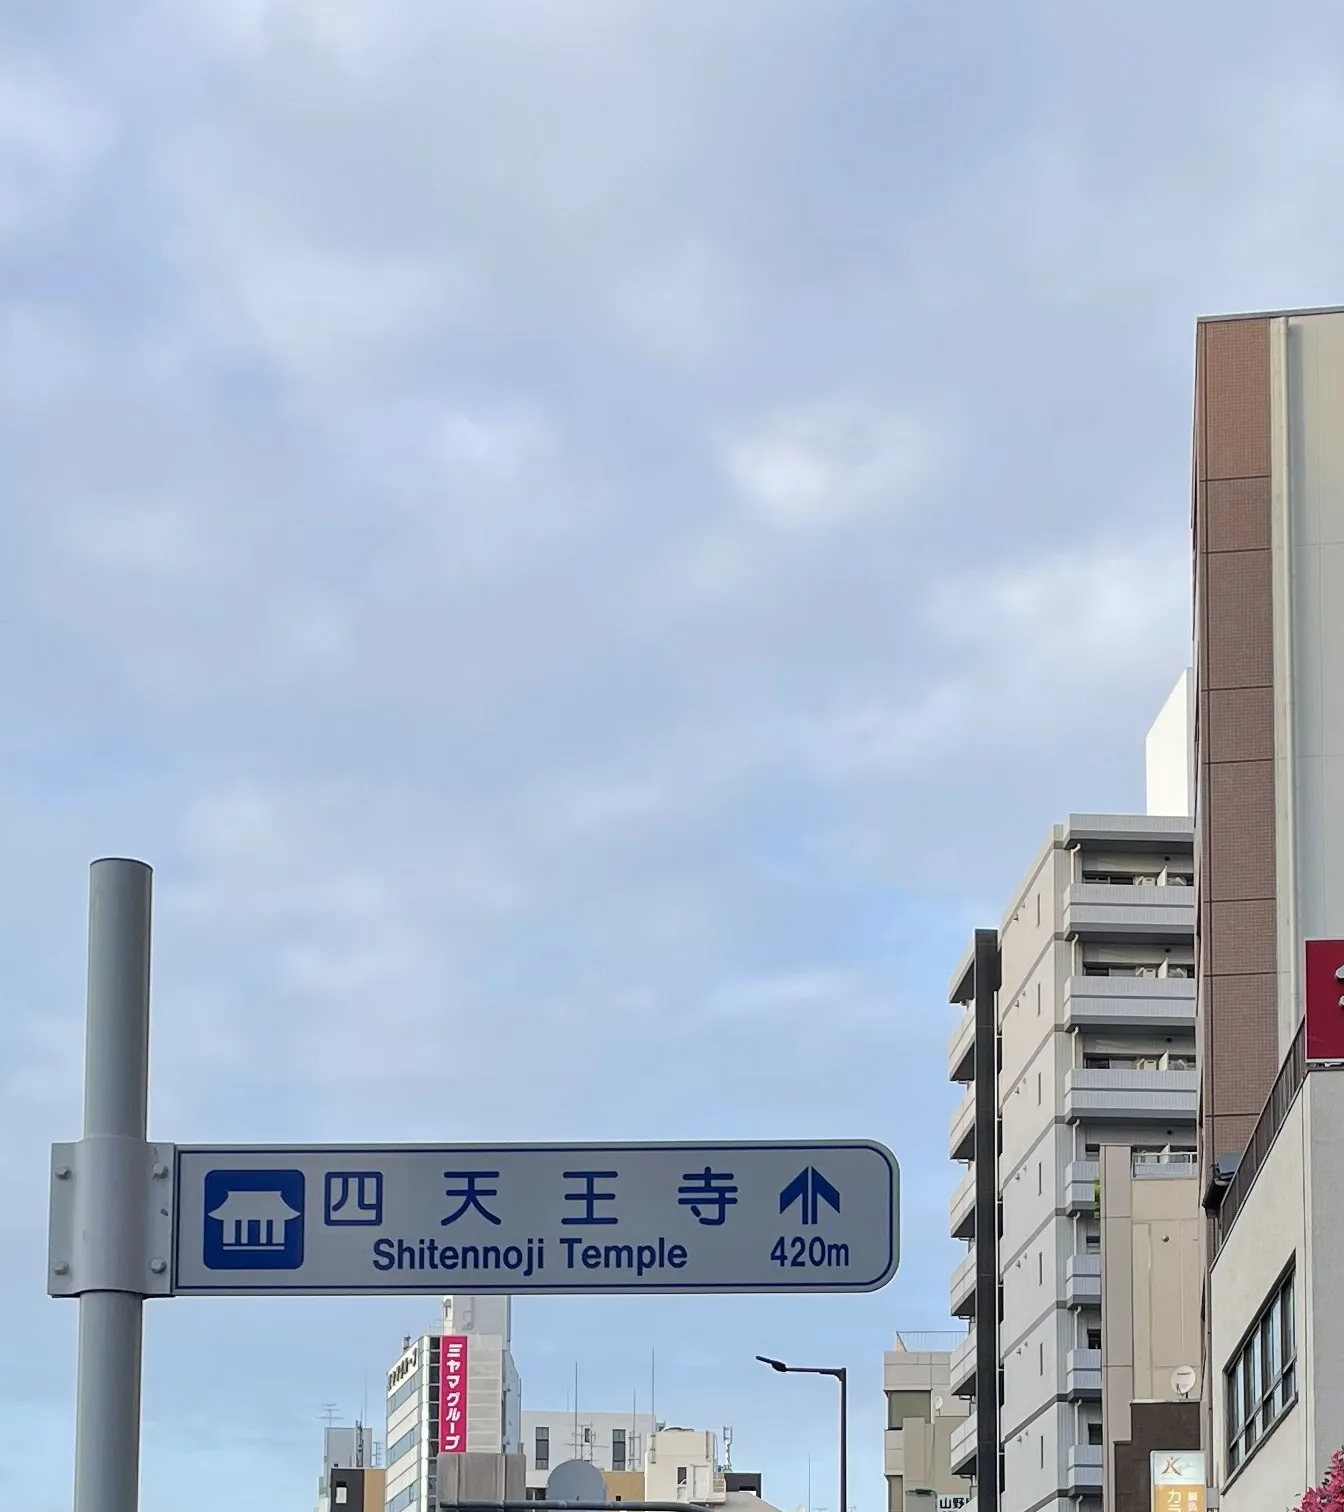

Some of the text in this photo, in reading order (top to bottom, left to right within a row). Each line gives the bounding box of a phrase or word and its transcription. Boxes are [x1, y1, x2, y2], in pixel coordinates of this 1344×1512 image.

[324, 1165, 740, 1228] 四天王寺
[372, 1237, 688, 1276] Shitennoji Temple
[769, 1236, 851, 1268] 420m
[444, 1343, 464, 1451] ミヤマグループ
